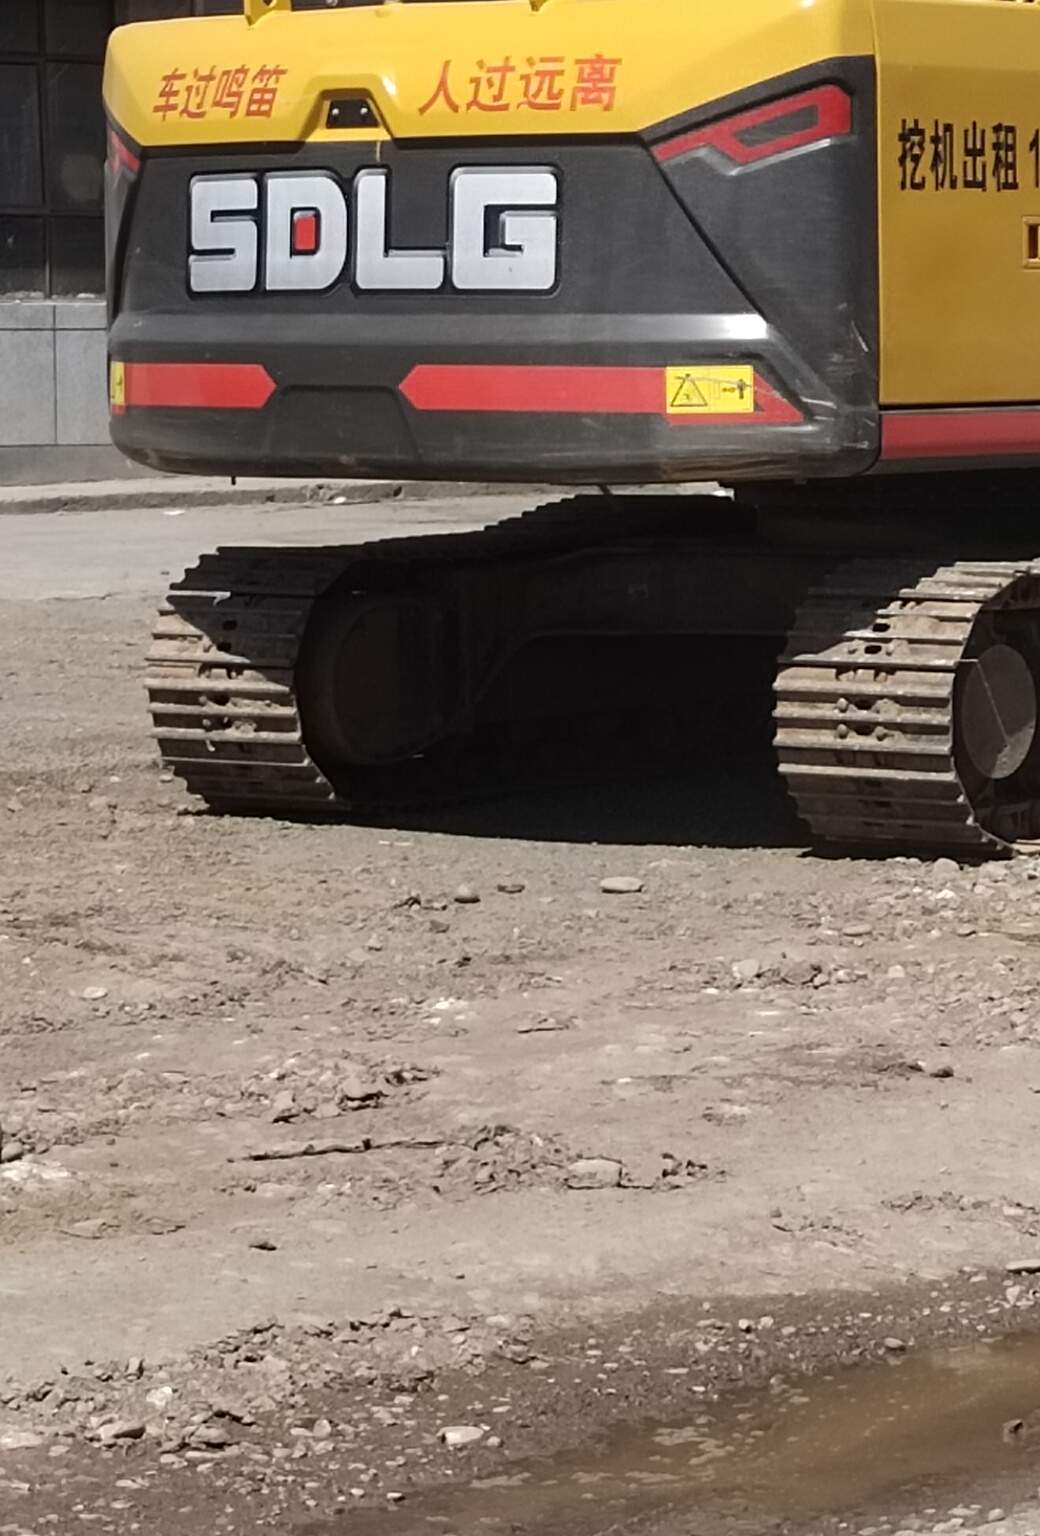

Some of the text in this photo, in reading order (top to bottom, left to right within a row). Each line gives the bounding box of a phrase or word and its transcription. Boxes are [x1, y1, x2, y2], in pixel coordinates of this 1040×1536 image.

[152, 64, 288, 121] 车过鸣笛
[419, 54, 622, 116] 人过远离
[897, 118, 1019, 193] 挖机出租
[188, 166, 558, 292] SDLG
